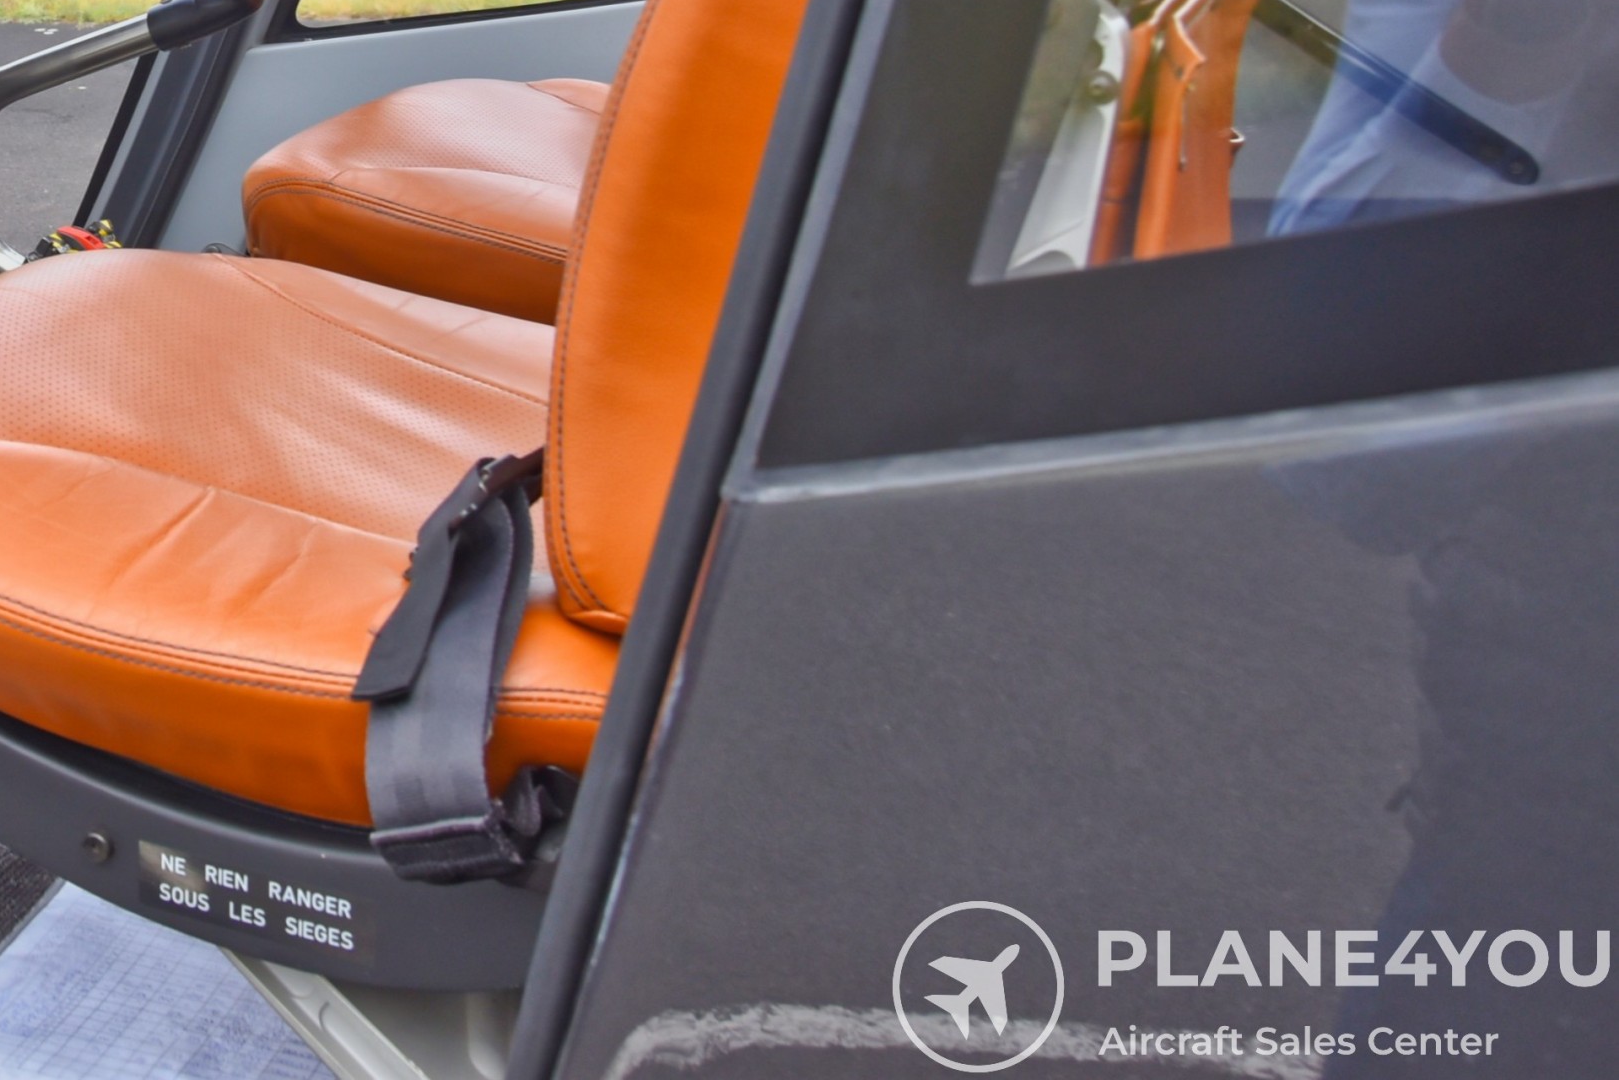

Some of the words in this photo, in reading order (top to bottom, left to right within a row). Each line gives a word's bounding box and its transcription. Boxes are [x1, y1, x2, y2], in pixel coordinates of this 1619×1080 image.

[159, 883, 210, 912] SOUS
[229, 901, 266, 927] LES
[285, 916, 353, 950] SIEGES
[160, 854, 186, 875] NE
[204, 865, 249, 892] RIEN
[268, 881, 351, 918] RANGER
